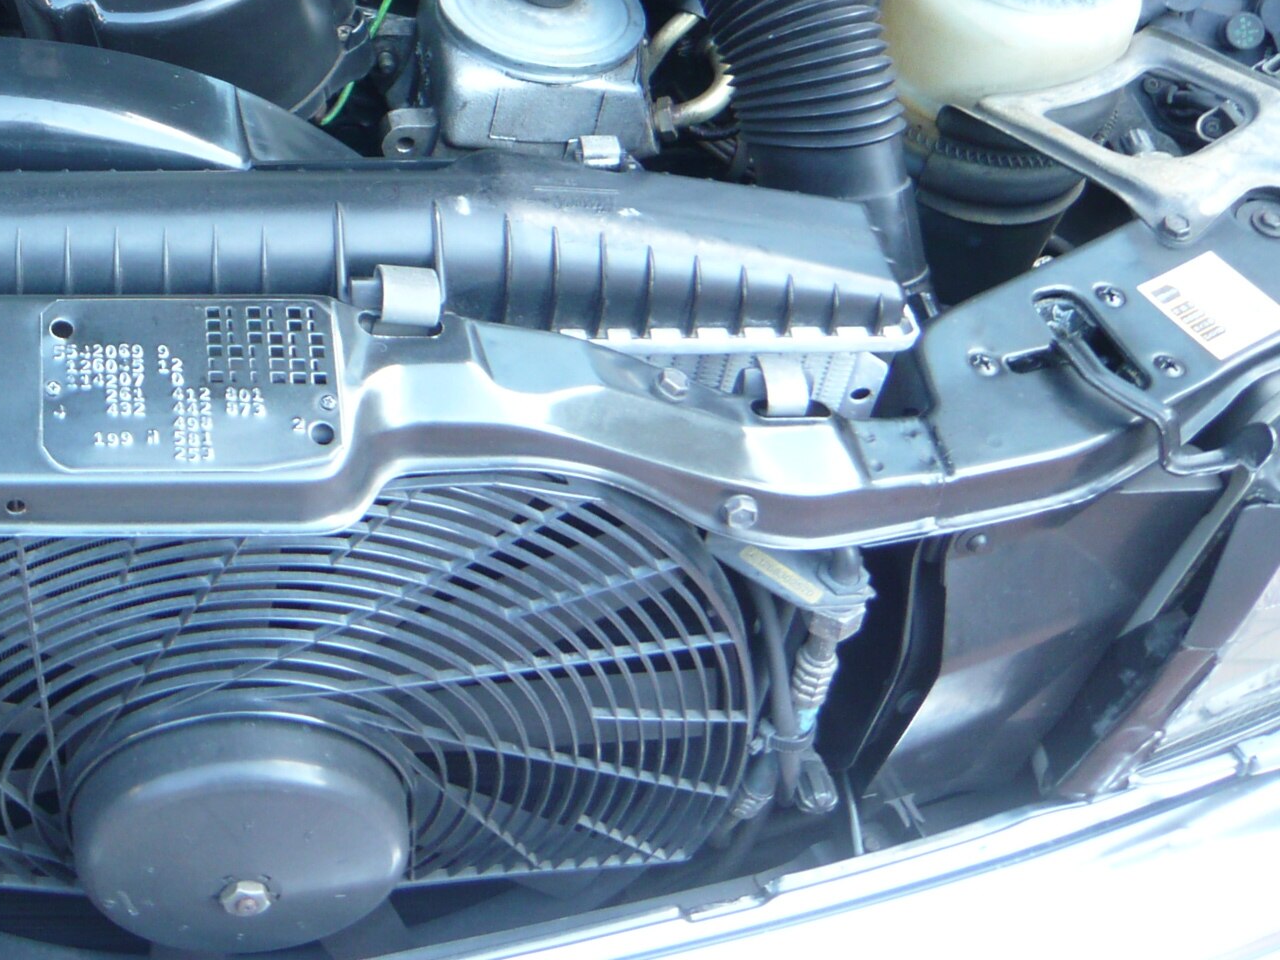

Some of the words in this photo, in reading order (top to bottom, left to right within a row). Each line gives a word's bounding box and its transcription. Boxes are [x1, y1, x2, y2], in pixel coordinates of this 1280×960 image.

[157, 344, 169, 359] 9
[158, 357, 183, 374] 12
[171, 372, 184, 387] 0
[106, 386, 145, 403] 261
[172, 386, 211, 402] 412
[225, 386, 265, 402] 801
[106, 401, 146, 418] 432
[173, 401, 212, 416] 442
[225, 401, 267, 418] 873
[173, 416, 214, 432] 498
[292, 416, 307, 434] 2
[94, 431, 134, 448] 199
[174, 430, 213, 447] 581
